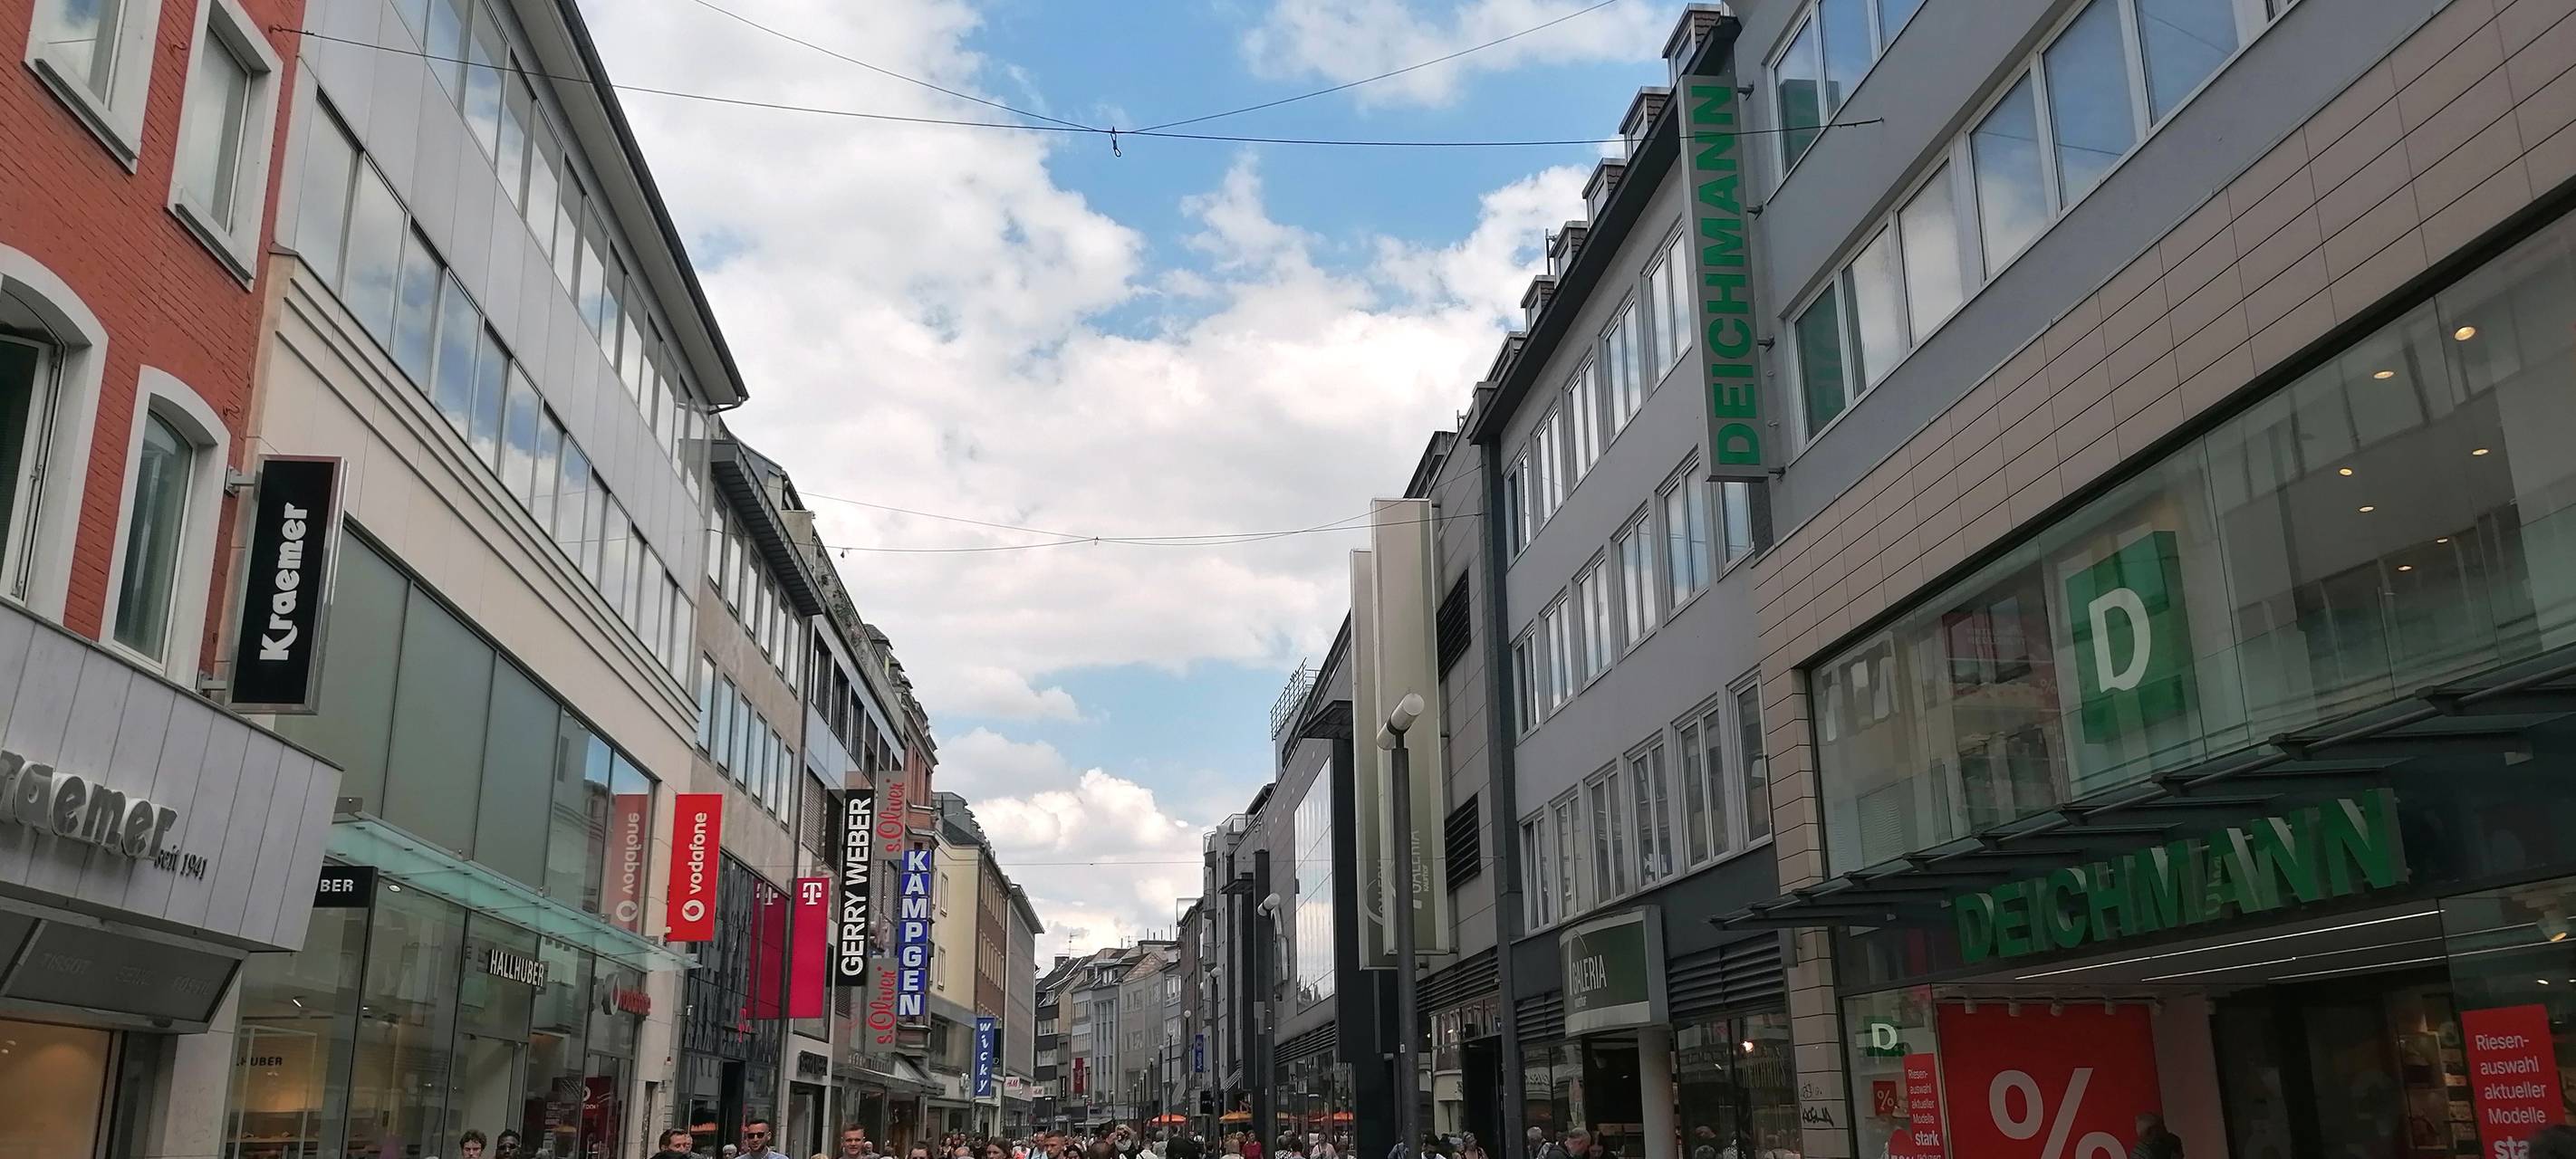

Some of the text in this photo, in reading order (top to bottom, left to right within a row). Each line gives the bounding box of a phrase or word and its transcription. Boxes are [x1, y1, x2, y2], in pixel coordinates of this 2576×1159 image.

[1690, 85, 1761, 465] DEICHMANN
[259, 502, 308, 661] Kraemer
[2088, 587, 2151, 694] D
[687, 812, 708, 895] vodafone
[845, 798, 871, 886] WEBER
[153, 844, 207, 882] seit 1941
[1956, 788, 2409, 963] DEICHMANN
[803, 882, 822, 905] T
[841, 891, 868, 976] GERRY
[489, 949, 543, 988] HALLHUBER
[1572, 954, 1608, 994] GALERIA
[1870, 1022, 1898, 1049] D
[2475, 1034, 2530, 1051] Riesen-
[977, 1022, 992, 1093] wicky
[2480, 1055, 2540, 1076] auswahl
[2485, 1081, 2547, 1100] aktueller
[1913, 1113, 1935, 1125] Modelle
[2487, 1106, 2547, 1125] Modelle
[1915, 1129, 1940, 1146] stark
